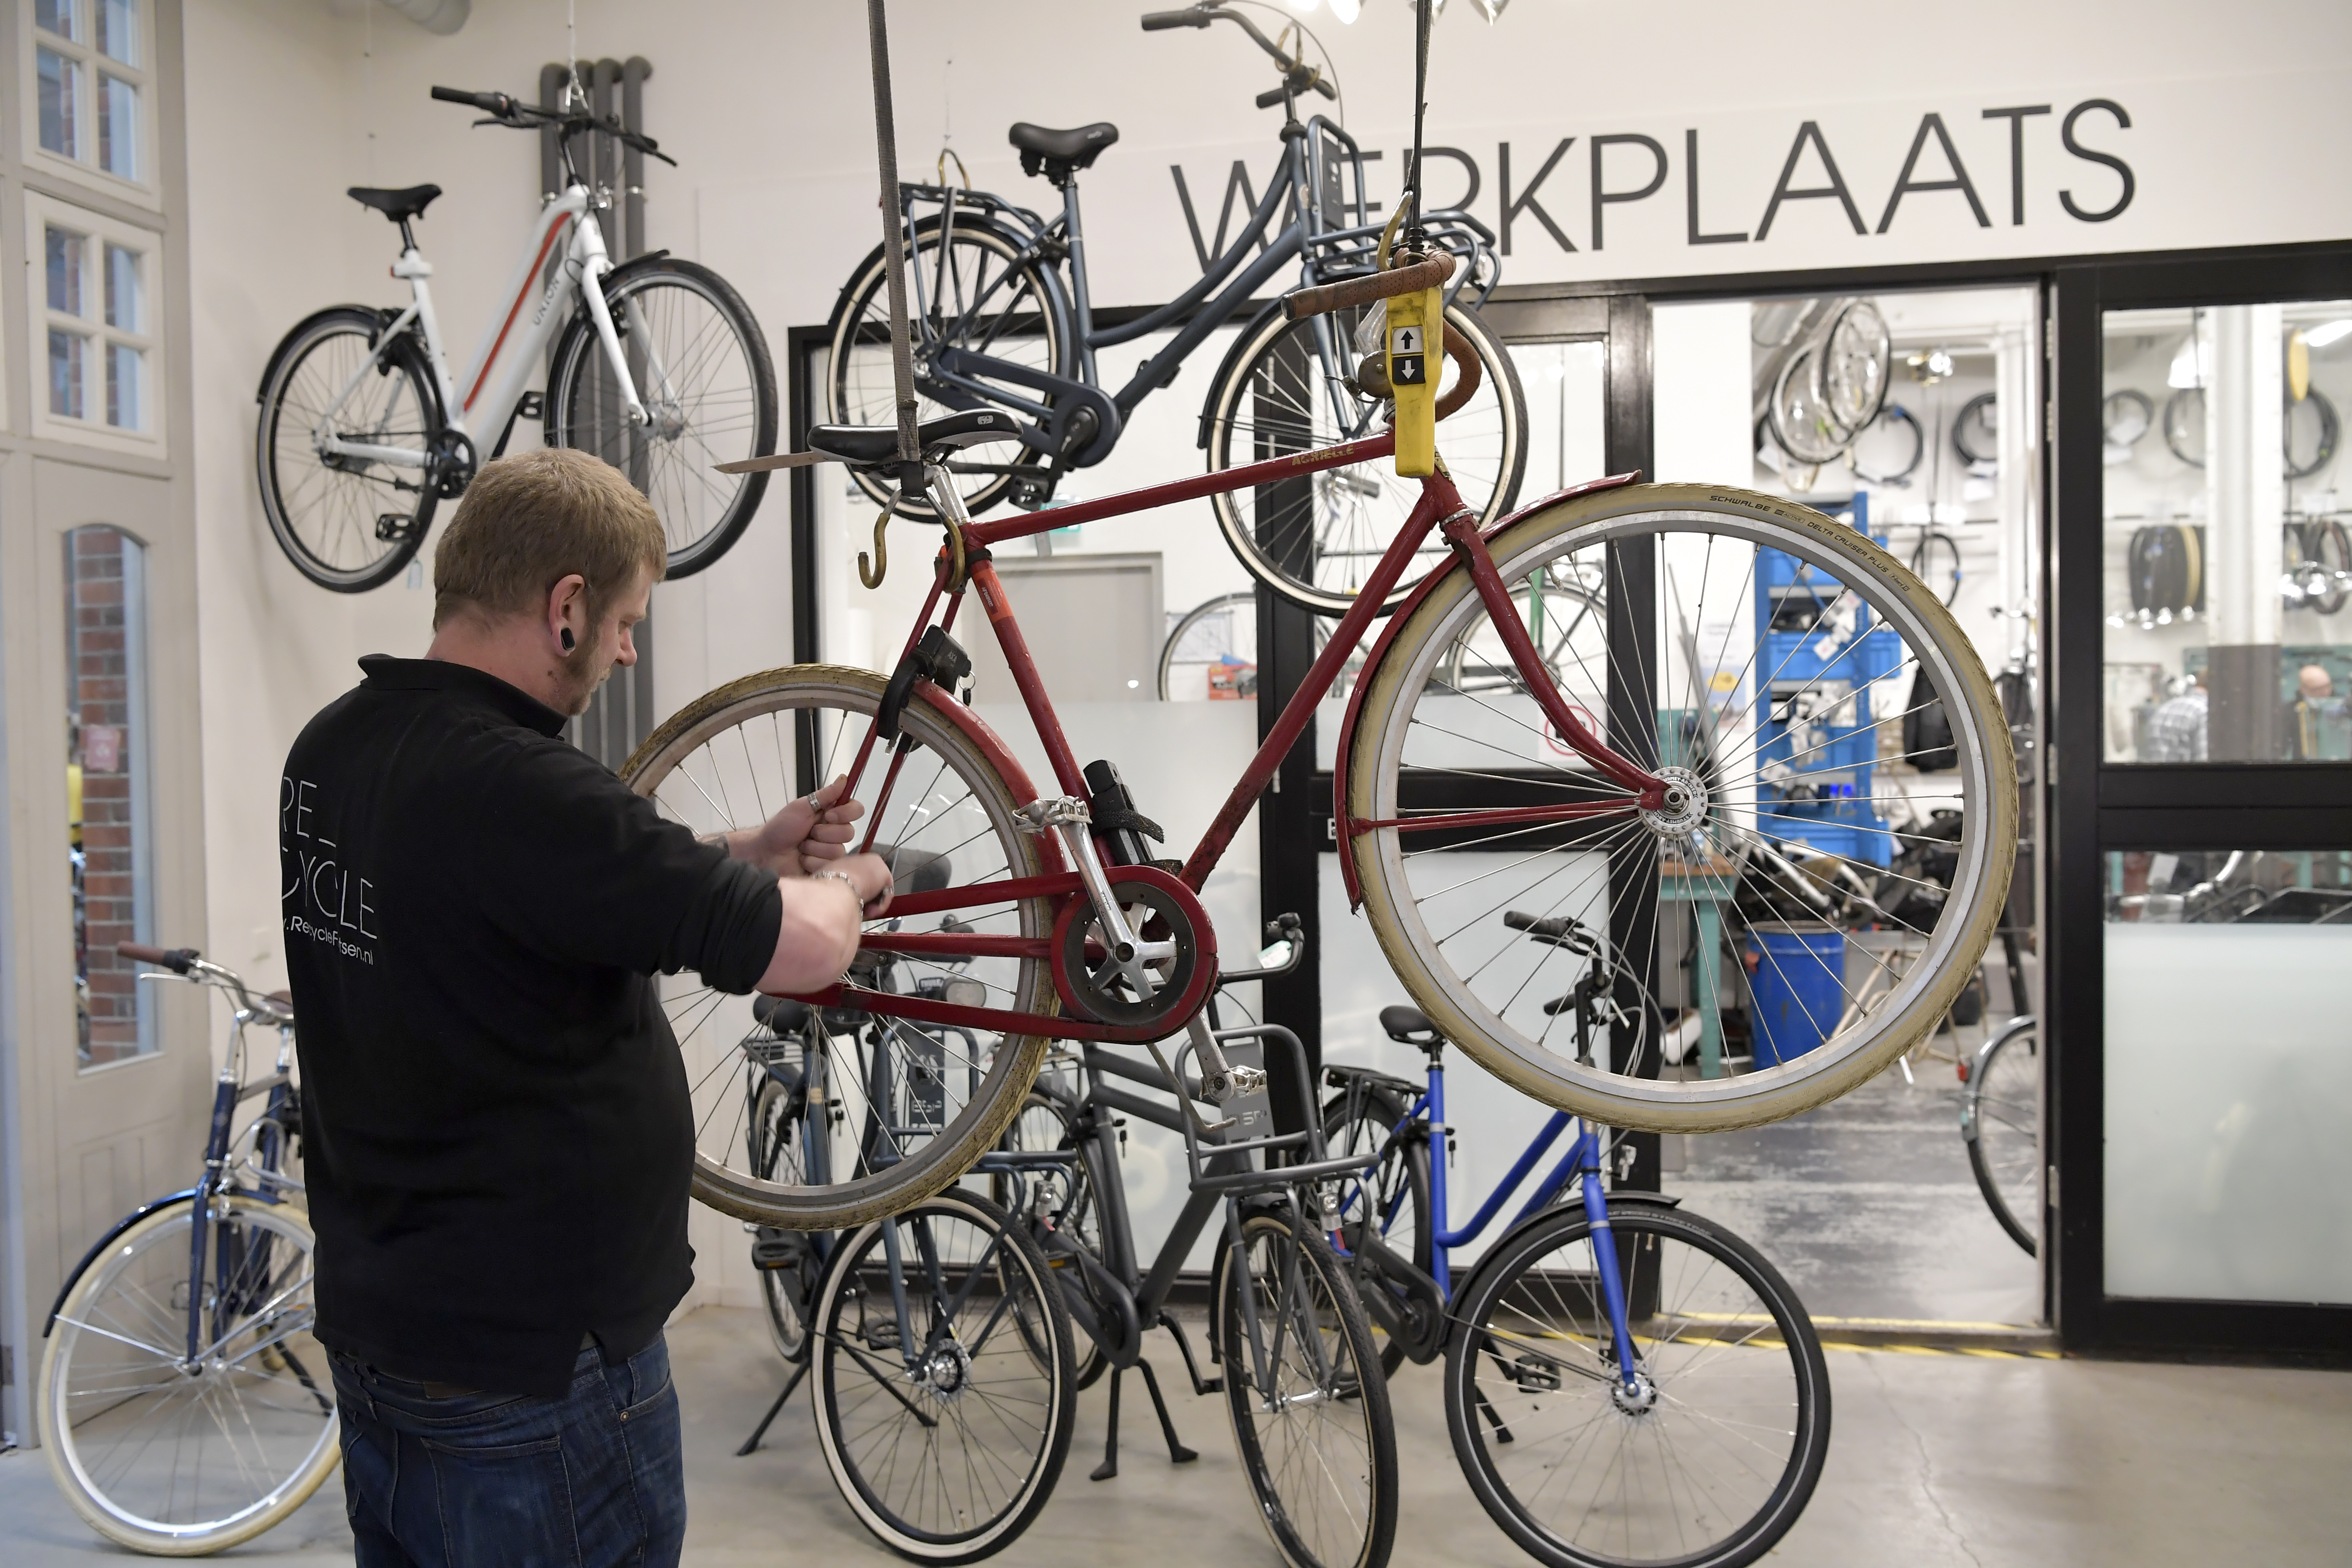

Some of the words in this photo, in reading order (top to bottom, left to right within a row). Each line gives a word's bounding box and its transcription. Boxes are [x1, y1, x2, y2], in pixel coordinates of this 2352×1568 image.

[1709, 495, 1771, 512] SCHWALBE
[1807, 520, 1834, 537] DELTA
[1834, 534, 1868, 558] CRUISER
[1867, 555, 1889, 574] PLUS
[1653, 811, 1690, 824] STURMEY-ARCH
